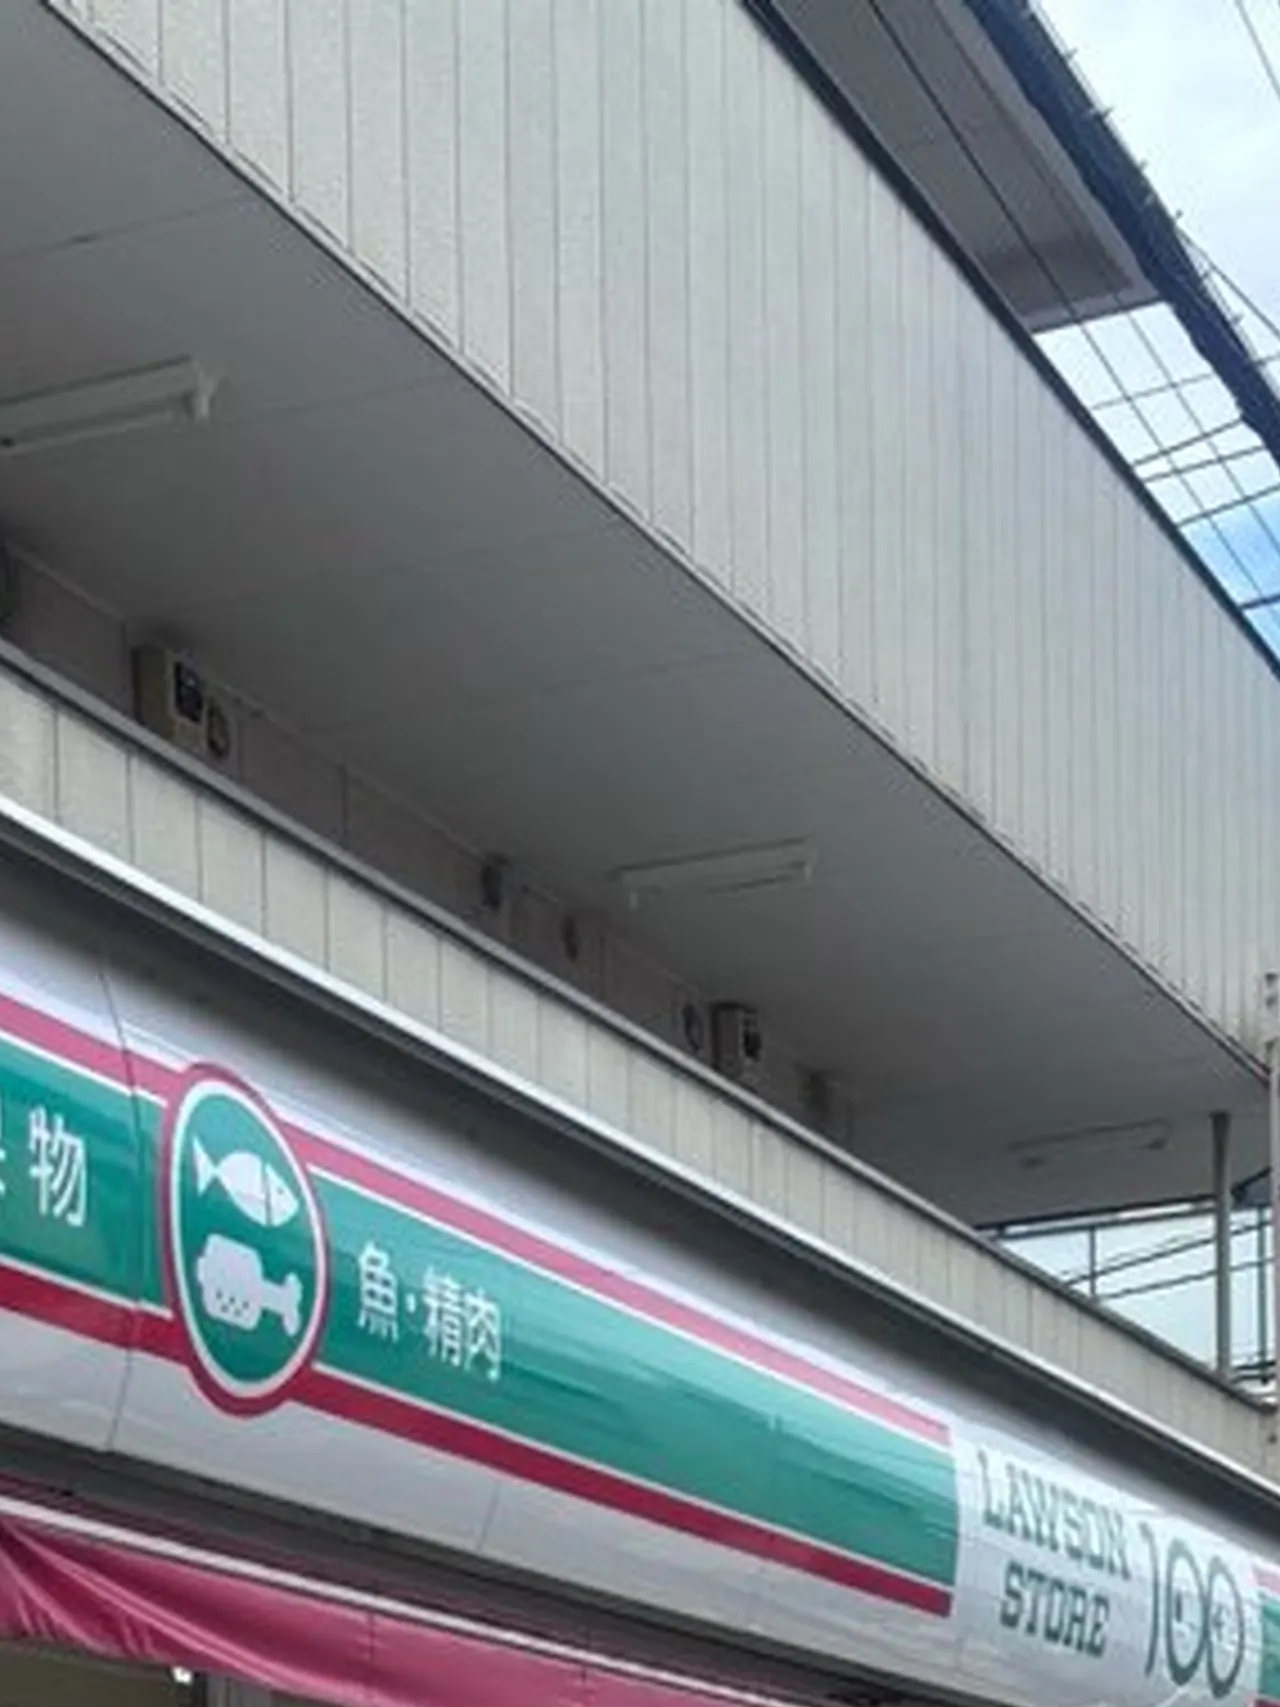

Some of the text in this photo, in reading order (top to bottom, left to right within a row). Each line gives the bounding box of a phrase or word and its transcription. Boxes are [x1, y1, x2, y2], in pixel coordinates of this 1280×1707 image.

[977, 1450, 1133, 1581] LAWSON
[999, 1562, 1110, 1659] STORE
[1139, 1521, 1245, 1699] 100
